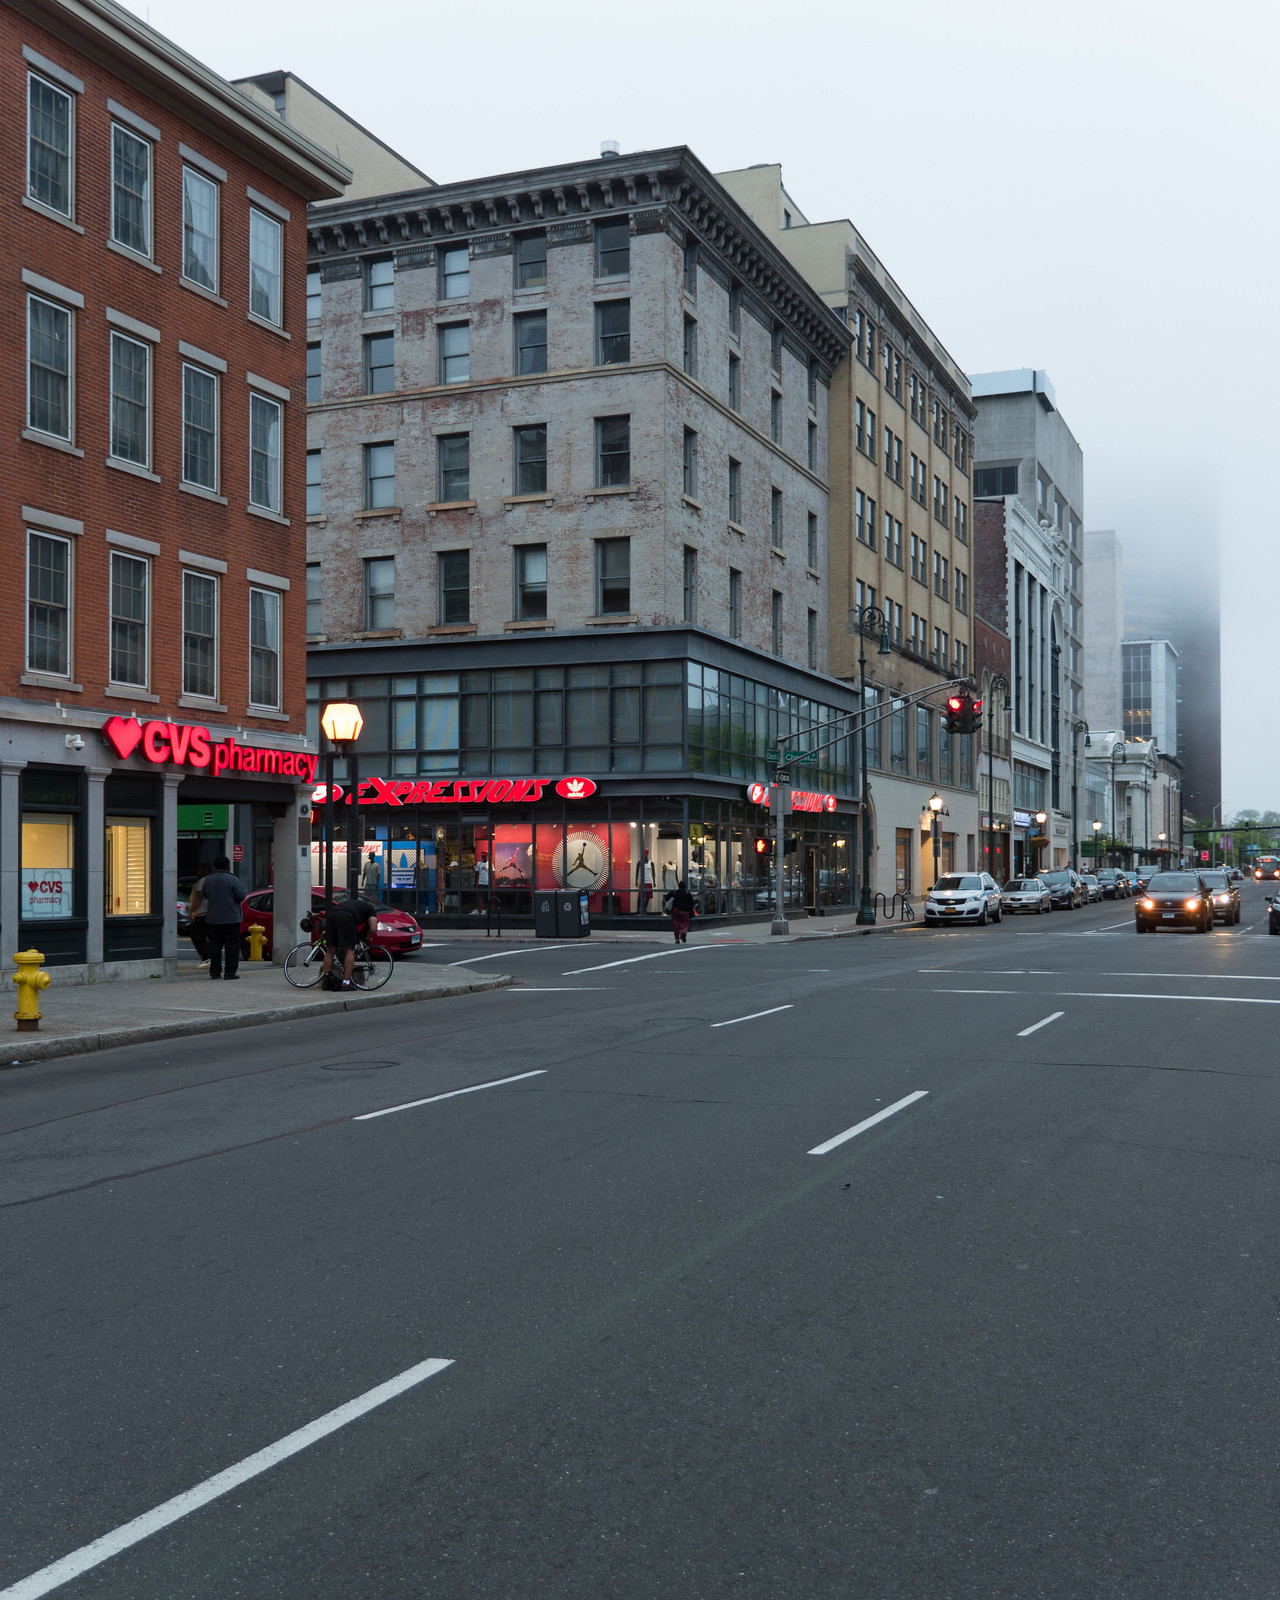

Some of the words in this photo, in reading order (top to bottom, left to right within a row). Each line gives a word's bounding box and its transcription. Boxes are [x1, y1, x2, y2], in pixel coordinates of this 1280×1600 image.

[142, 720, 211, 768] CVS
[209, 737, 318, 784] pharmacy
[39, 881, 63, 894] CVS
[29, 896, 62, 905] pharmacy
